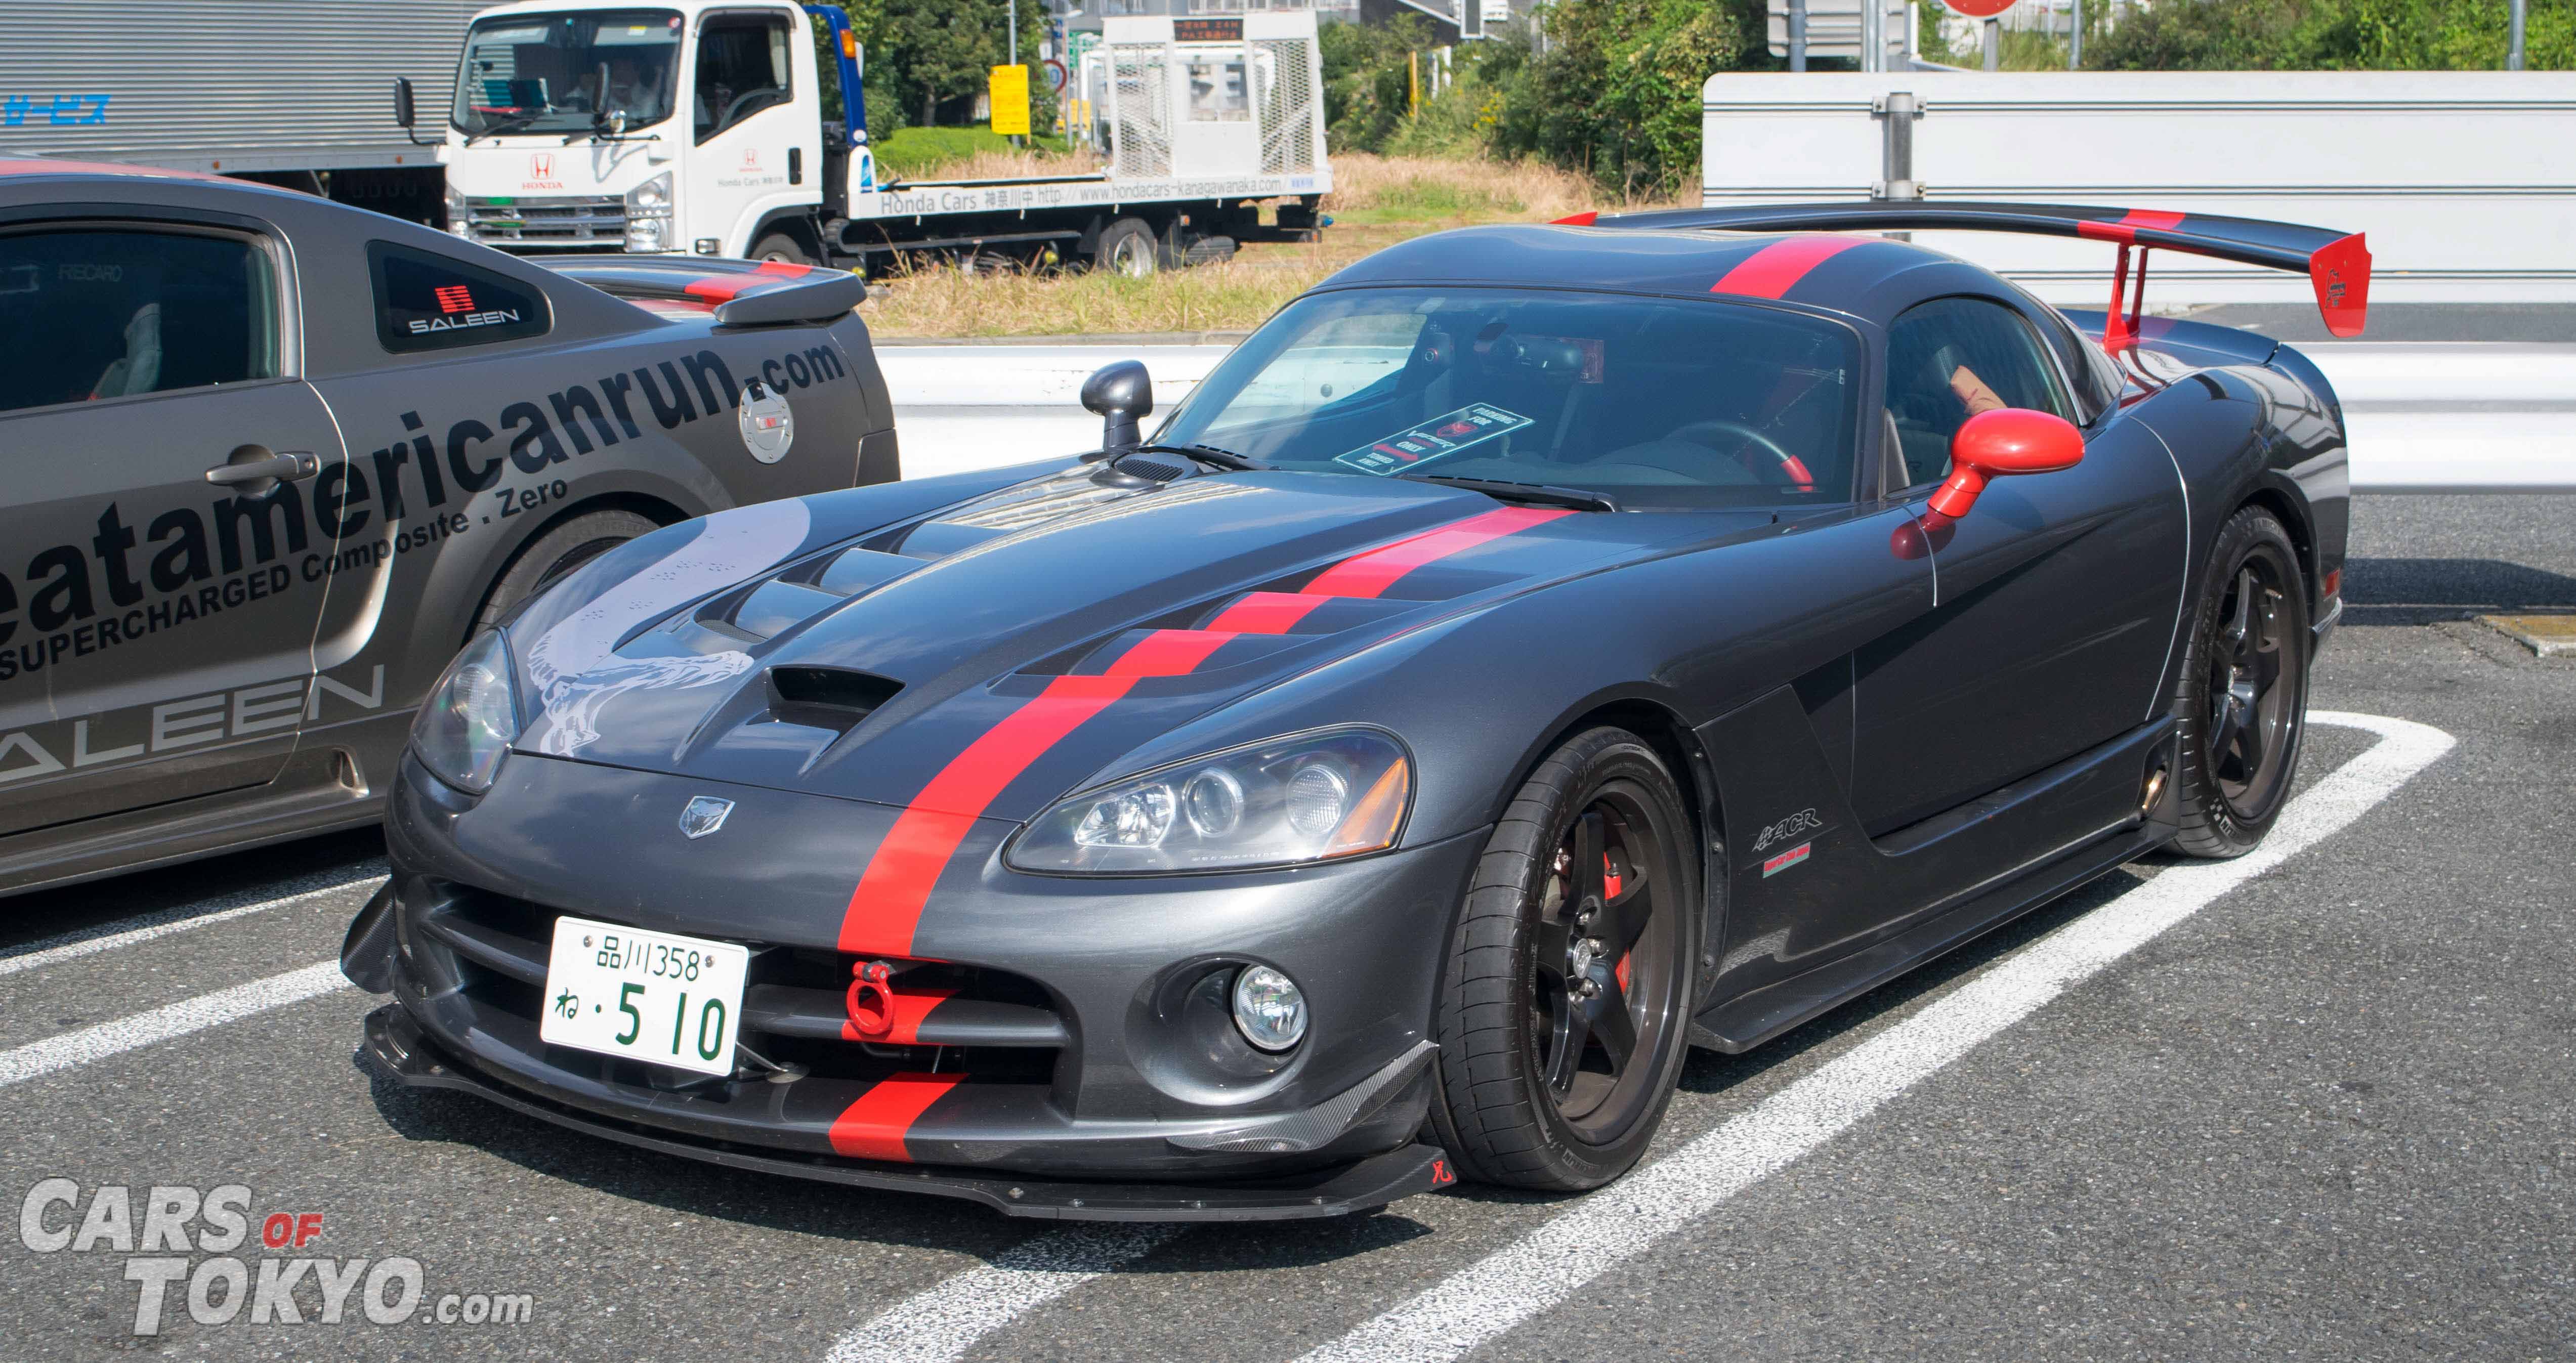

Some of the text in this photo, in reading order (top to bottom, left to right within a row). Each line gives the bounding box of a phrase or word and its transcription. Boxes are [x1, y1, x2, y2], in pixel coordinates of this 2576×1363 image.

[4, 95, 111, 125] サービス
[880, 194, 935, 215] Honda
[941, 192, 977, 211] Cars
[985, 189, 1033, 209] 神奈川中
[409, 309, 519, 334] SALEEN
[1468, 416, 1492, 425] FOR
[1473, 408, 1517, 424] PARKING
[1397, 441, 1426, 452] ONLY
[1407, 430, 1457, 447] VIPER
[1367, 453, 1395, 463] TOWED
[0, 564, 291, 680] SUPERCHARGED
[302, 511, 469, 583] Composite
[495, 479, 568, 518] Zero
[1763, 808, 1823, 844] ACR
[555, 987, 579, 1019] ね
